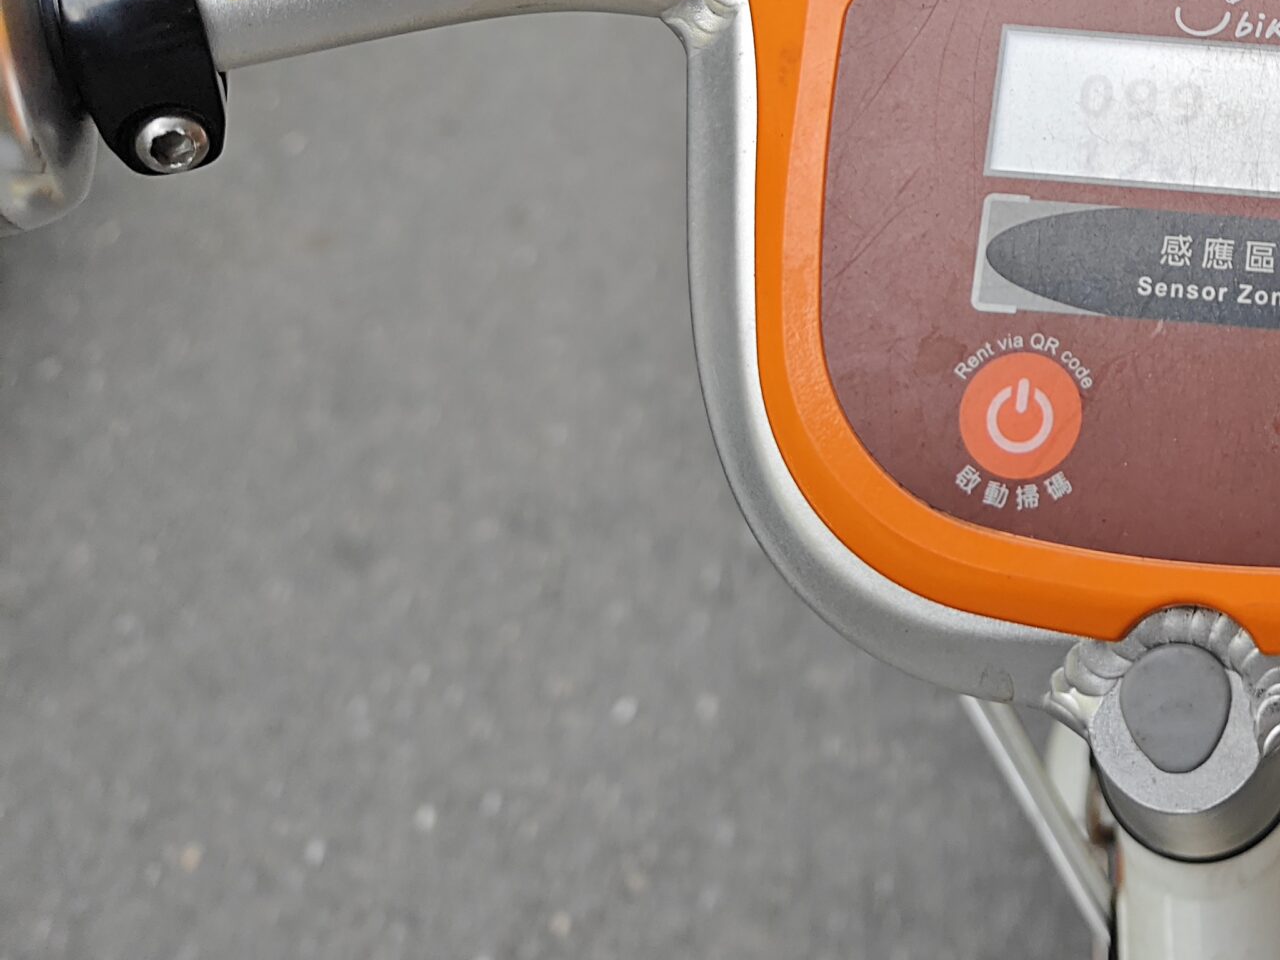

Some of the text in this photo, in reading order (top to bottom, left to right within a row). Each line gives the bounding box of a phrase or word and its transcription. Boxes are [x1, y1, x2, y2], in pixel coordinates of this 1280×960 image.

[1159, 233, 1277, 274] 感應區
[1137, 276, 1229, 303] Sensor
[953, 332, 1094, 390] Rent via QR code
[955, 464, 1073, 511] 啟動掃碼
